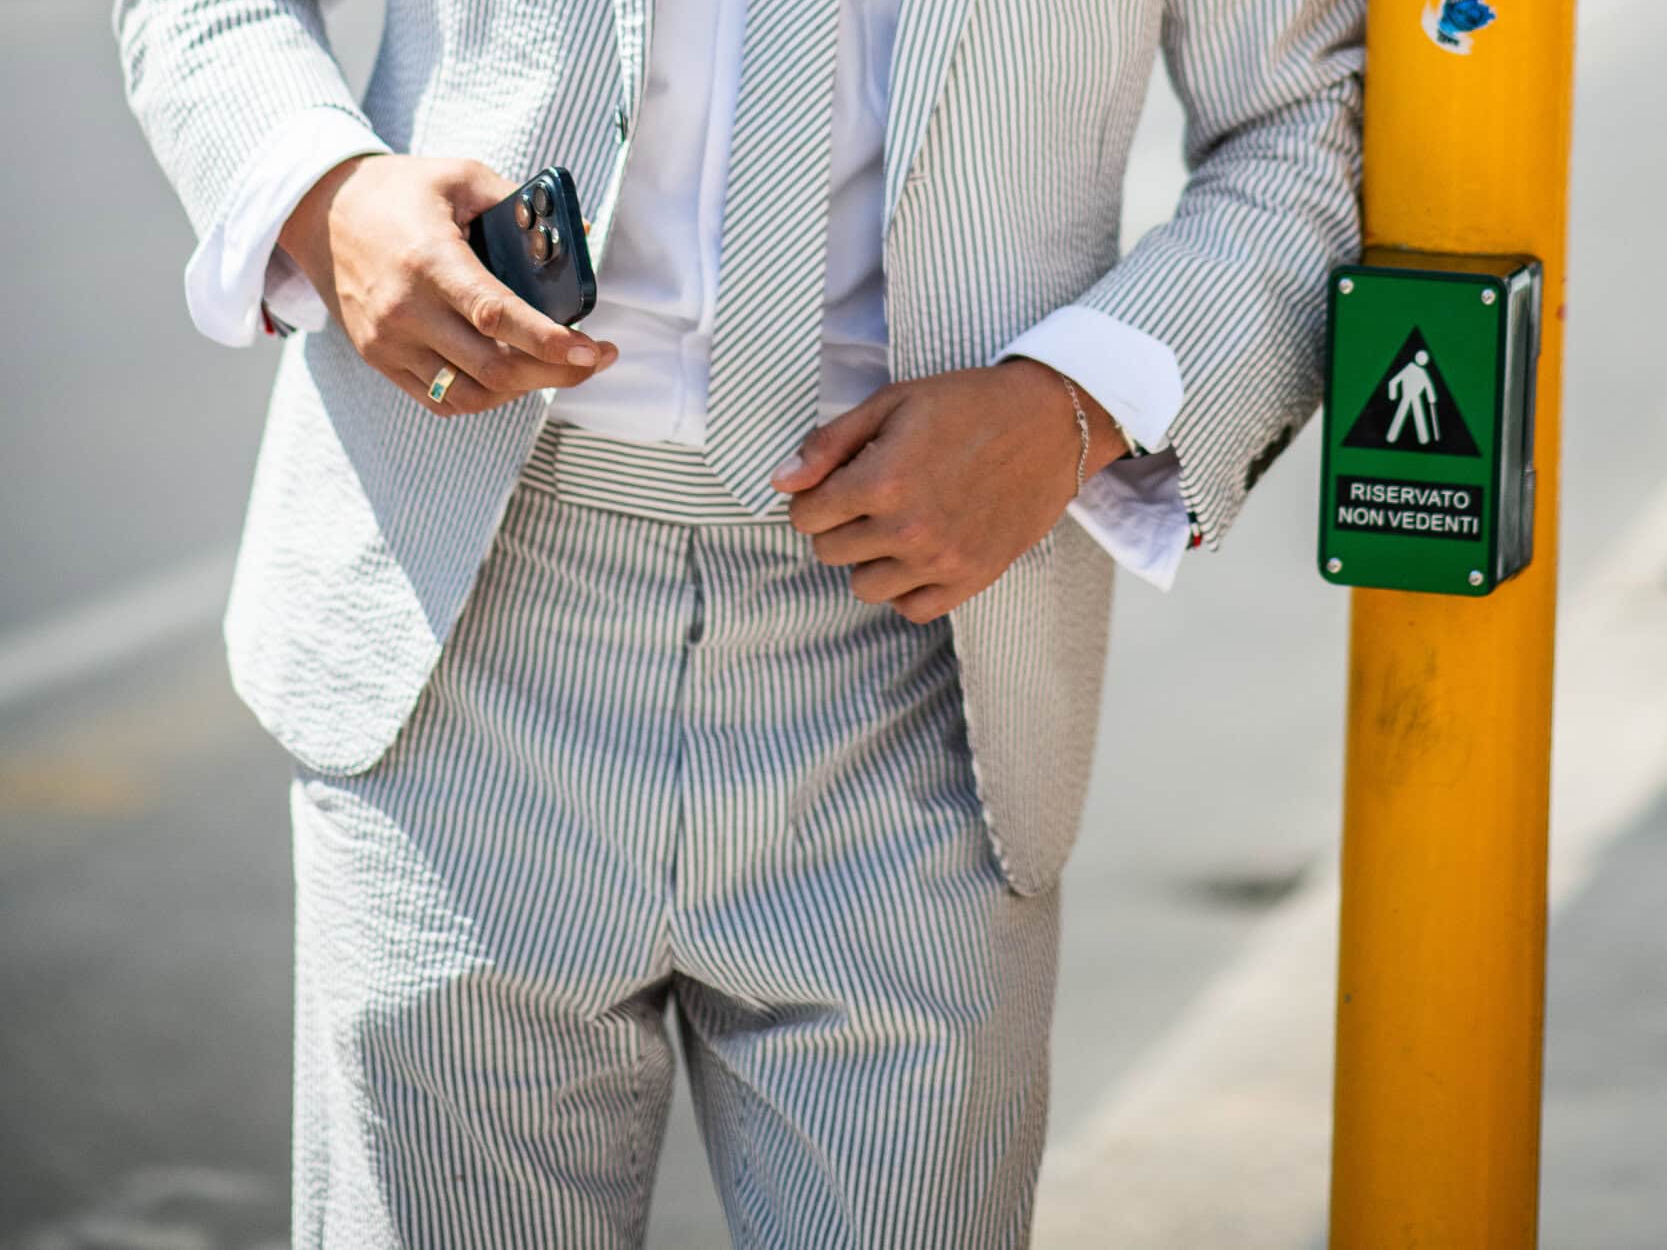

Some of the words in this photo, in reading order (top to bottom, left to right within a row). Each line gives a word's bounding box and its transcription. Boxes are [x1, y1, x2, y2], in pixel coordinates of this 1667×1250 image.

[1350, 483, 1471, 509] RISERVATO
[1338, 506, 1385, 527] NON
[1387, 510, 1479, 535] VEDENTI
